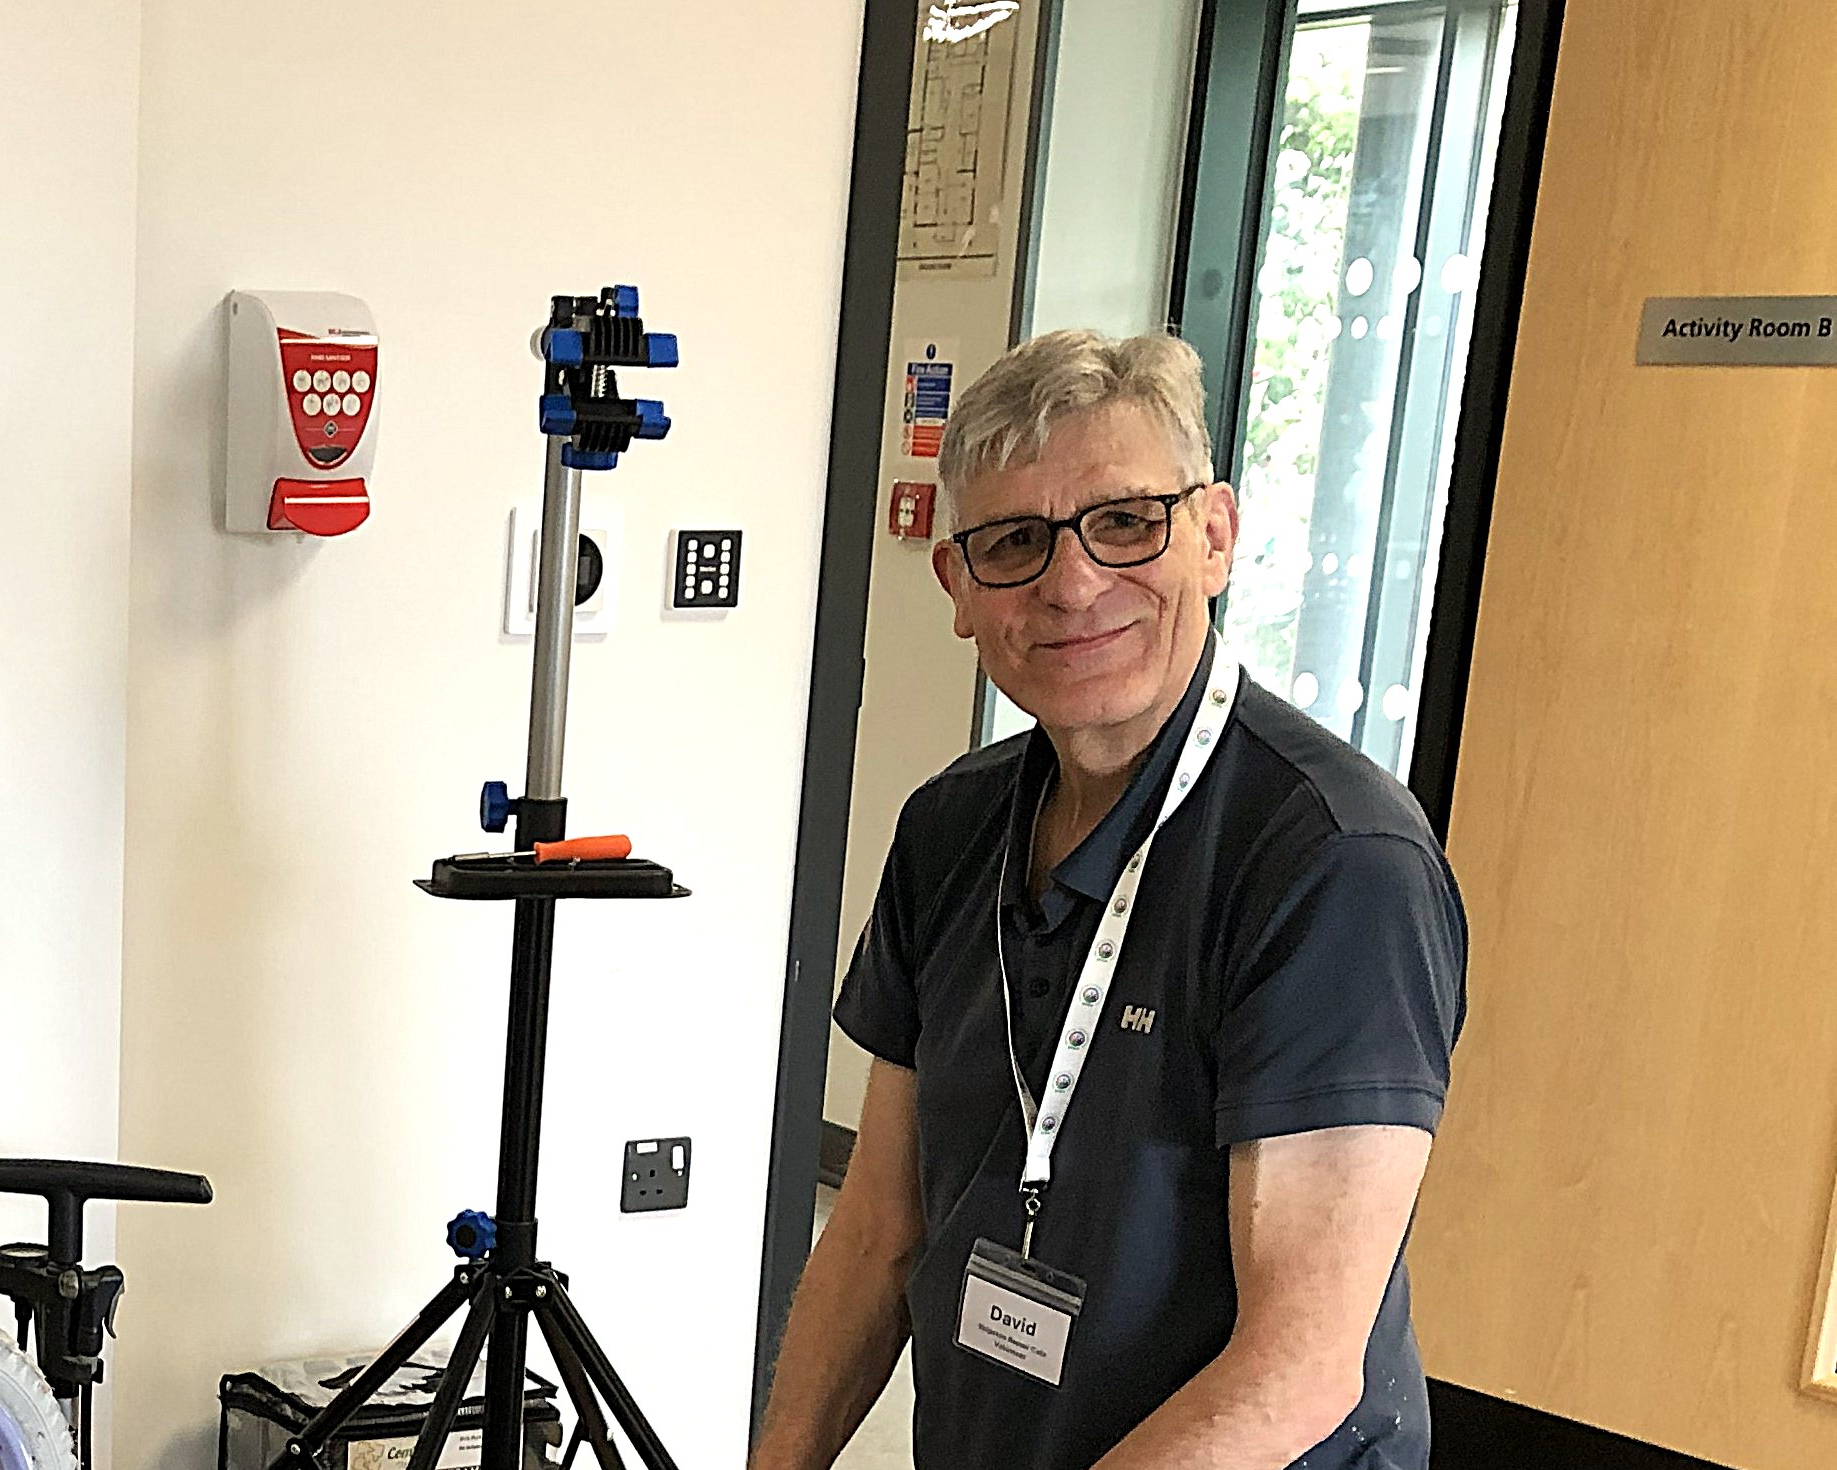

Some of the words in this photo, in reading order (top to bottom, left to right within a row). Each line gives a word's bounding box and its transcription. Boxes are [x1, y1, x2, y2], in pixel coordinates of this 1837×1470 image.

[1662, 317, 1744, 342] Activity
[1748, 318, 1810, 337] Room
[1817, 317, 1832, 337] B
[990, 1304, 1037, 1336] David
